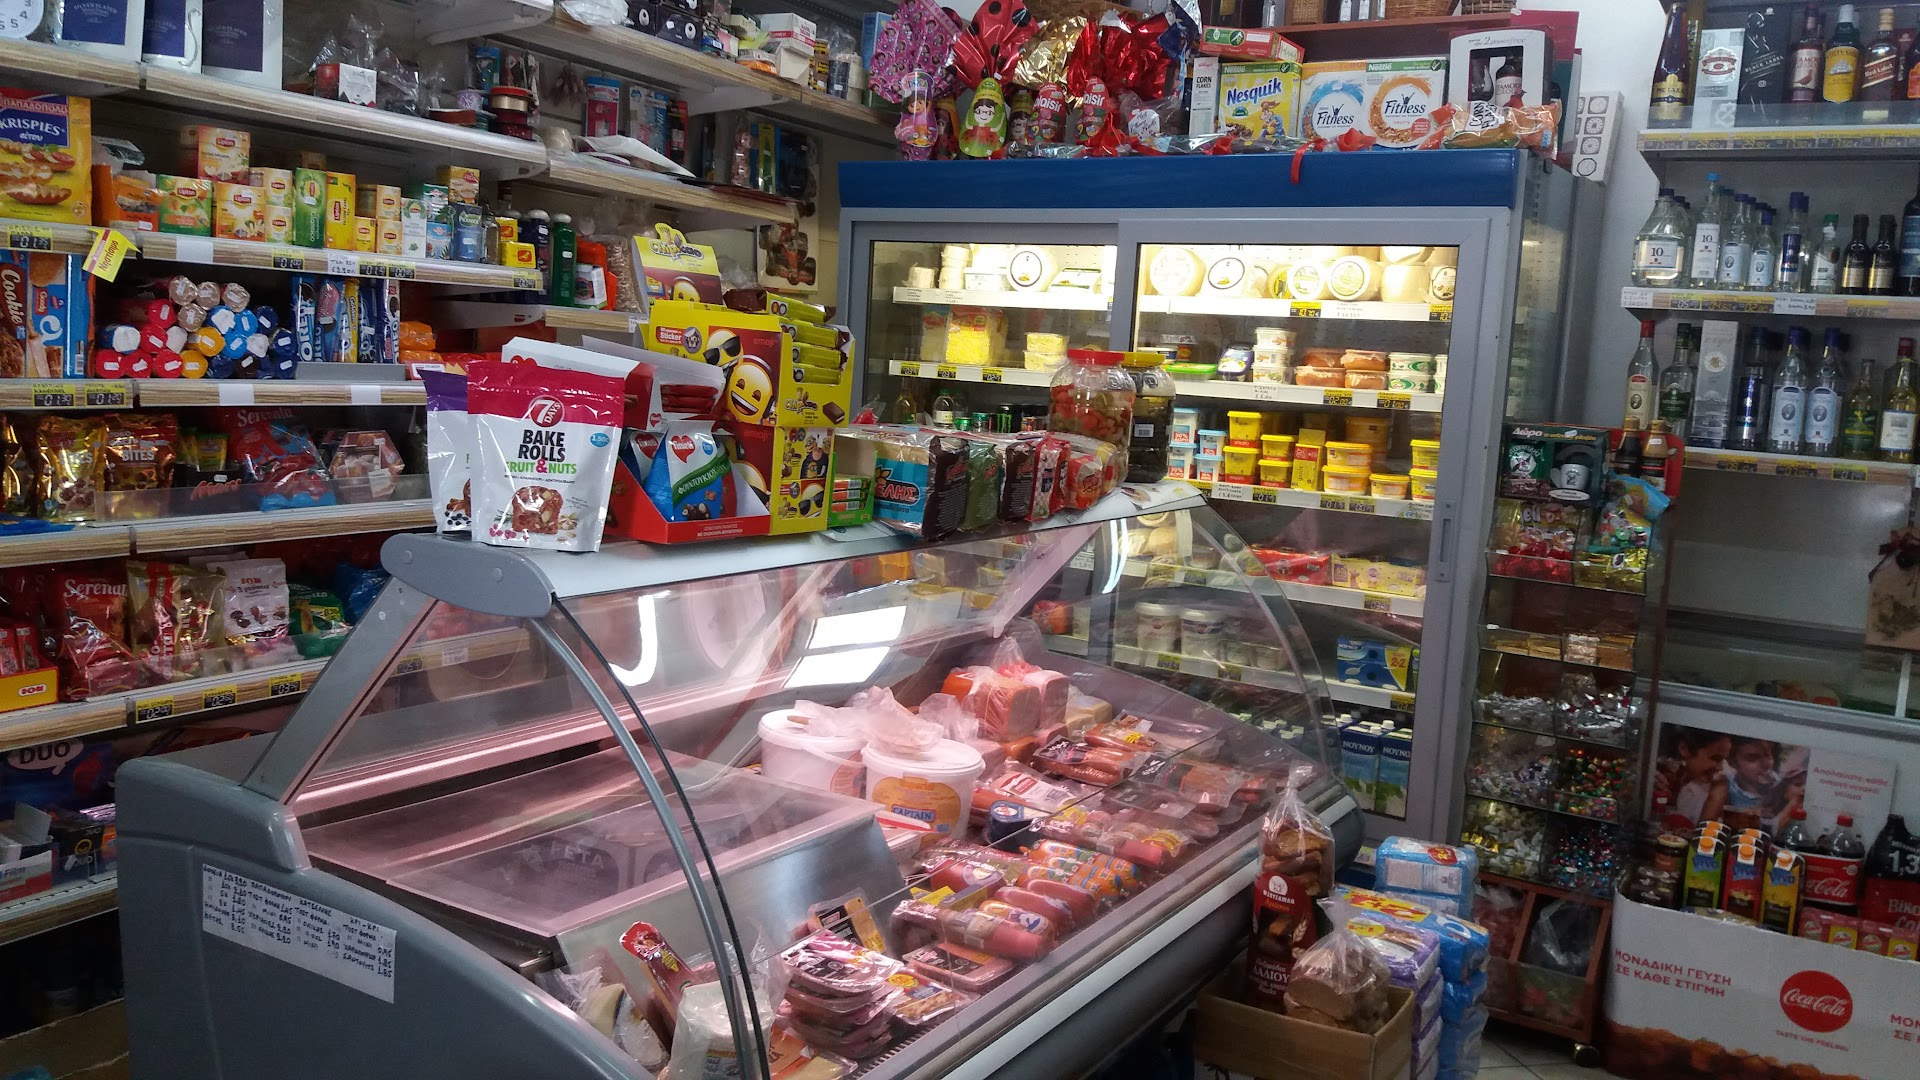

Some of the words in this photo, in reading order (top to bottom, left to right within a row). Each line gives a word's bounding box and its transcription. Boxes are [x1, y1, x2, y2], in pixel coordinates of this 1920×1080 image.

[19, 10, 28, 19] 4
[1368, 63, 1392, 72] Nestlé
[1765, 56, 1784, 66] LABEL
[1864, 68, 1877, 78] Red
[1877, 63, 1894, 74] Label
[1196, 76, 1212, 84] CORN
[1226, 77, 1282, 106] Nesquik
[1383, 100, 1427, 115] Fitness
[1316, 112, 1355, 126] Fitness
[217, 139, 235, 148] Lipton
[177, 187, 197, 198] Lipton
[271, 182, 286, 190] Lipton
[271, 219, 287, 228] Lipton
[1702, 234, 1714, 244] 10
[1651, 247, 1664, 258] 10
[1, 269, 25, 325] Cookie
[659, 332, 682, 342] Sticker
[543, 402, 562, 424] DAYS
[522, 429, 566, 448] BAKE
[1511, 427, 1543, 438] Δώρο
[121, 449, 155, 463] BITES
[518, 444, 566, 463] ROLLS
[19, 685, 46, 697] ION
[19, 742, 72, 765] DUO
[893, 807, 933, 821] CAPTAIN
[1614, 949, 1683, 975] ΜΟΝΑΔΙΚΗ
[1686, 968, 1732, 987] ΓΕΥΣΗ
[1615, 963, 1630, 977] ΣΕ
[1634, 969, 1671, 986] ΚΑΘΕ
[1675, 979, 1725, 998] ΣΤΙΓΜΗ
[1783, 988, 1848, 1017] Coca-Cola
[1894, 1029, 1912, 1042] ΣΕ
